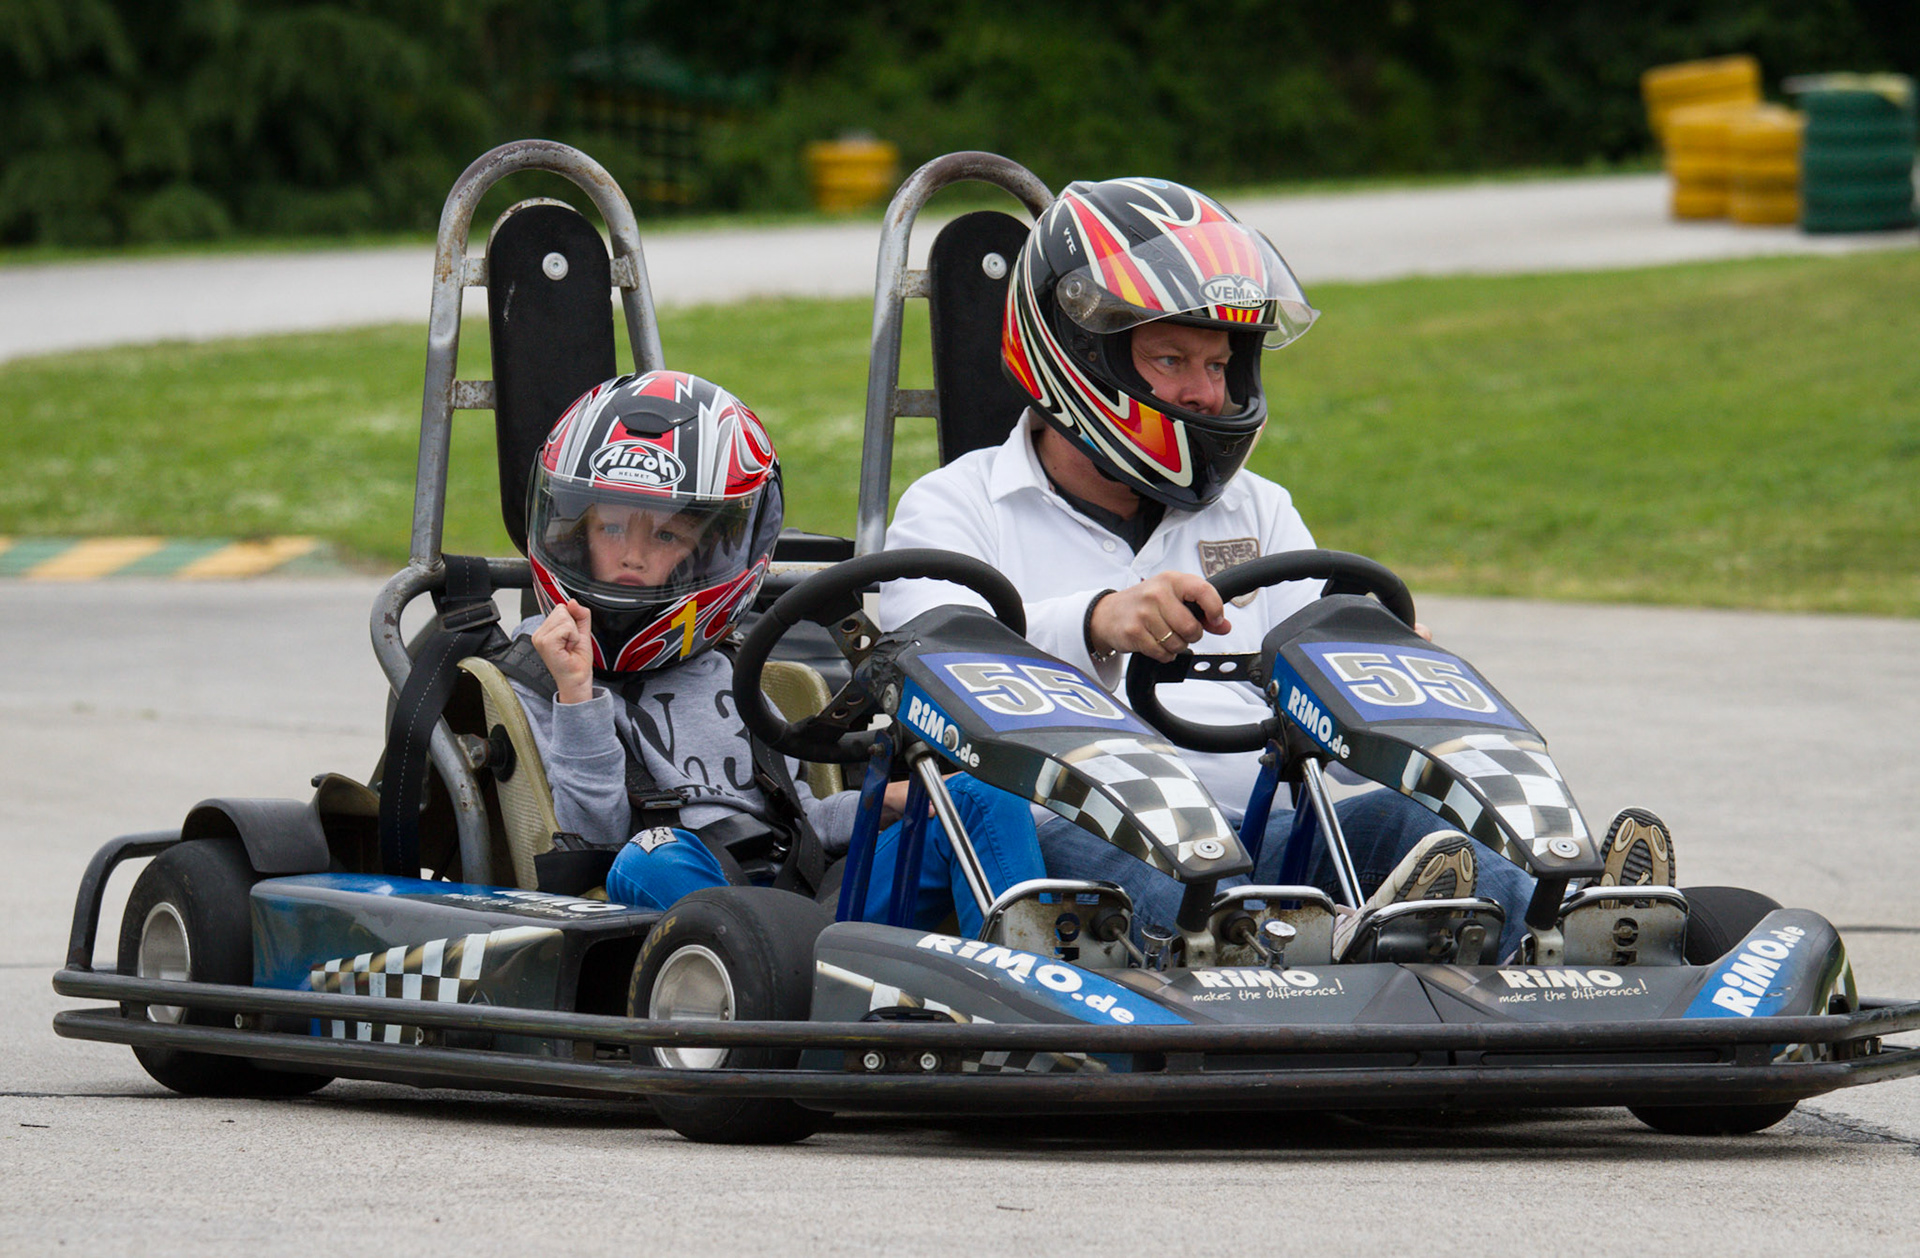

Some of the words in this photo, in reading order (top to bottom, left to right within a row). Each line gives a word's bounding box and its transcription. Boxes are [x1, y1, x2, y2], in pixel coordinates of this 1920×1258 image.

[595, 446, 676, 480] Airoh
[618, 471, 650, 480] HELMET
[943, 662, 1126, 721] 55
[1322, 652, 1499, 714] 55
[1191, 991, 1232, 1003] makes
[1237, 989, 1262, 1002] the
[1266, 977, 1346, 1000] difference!
[1498, 992, 1538, 1004] makes
[1544, 990, 1567, 1002] the
[1571, 977, 1650, 1001] difference!
